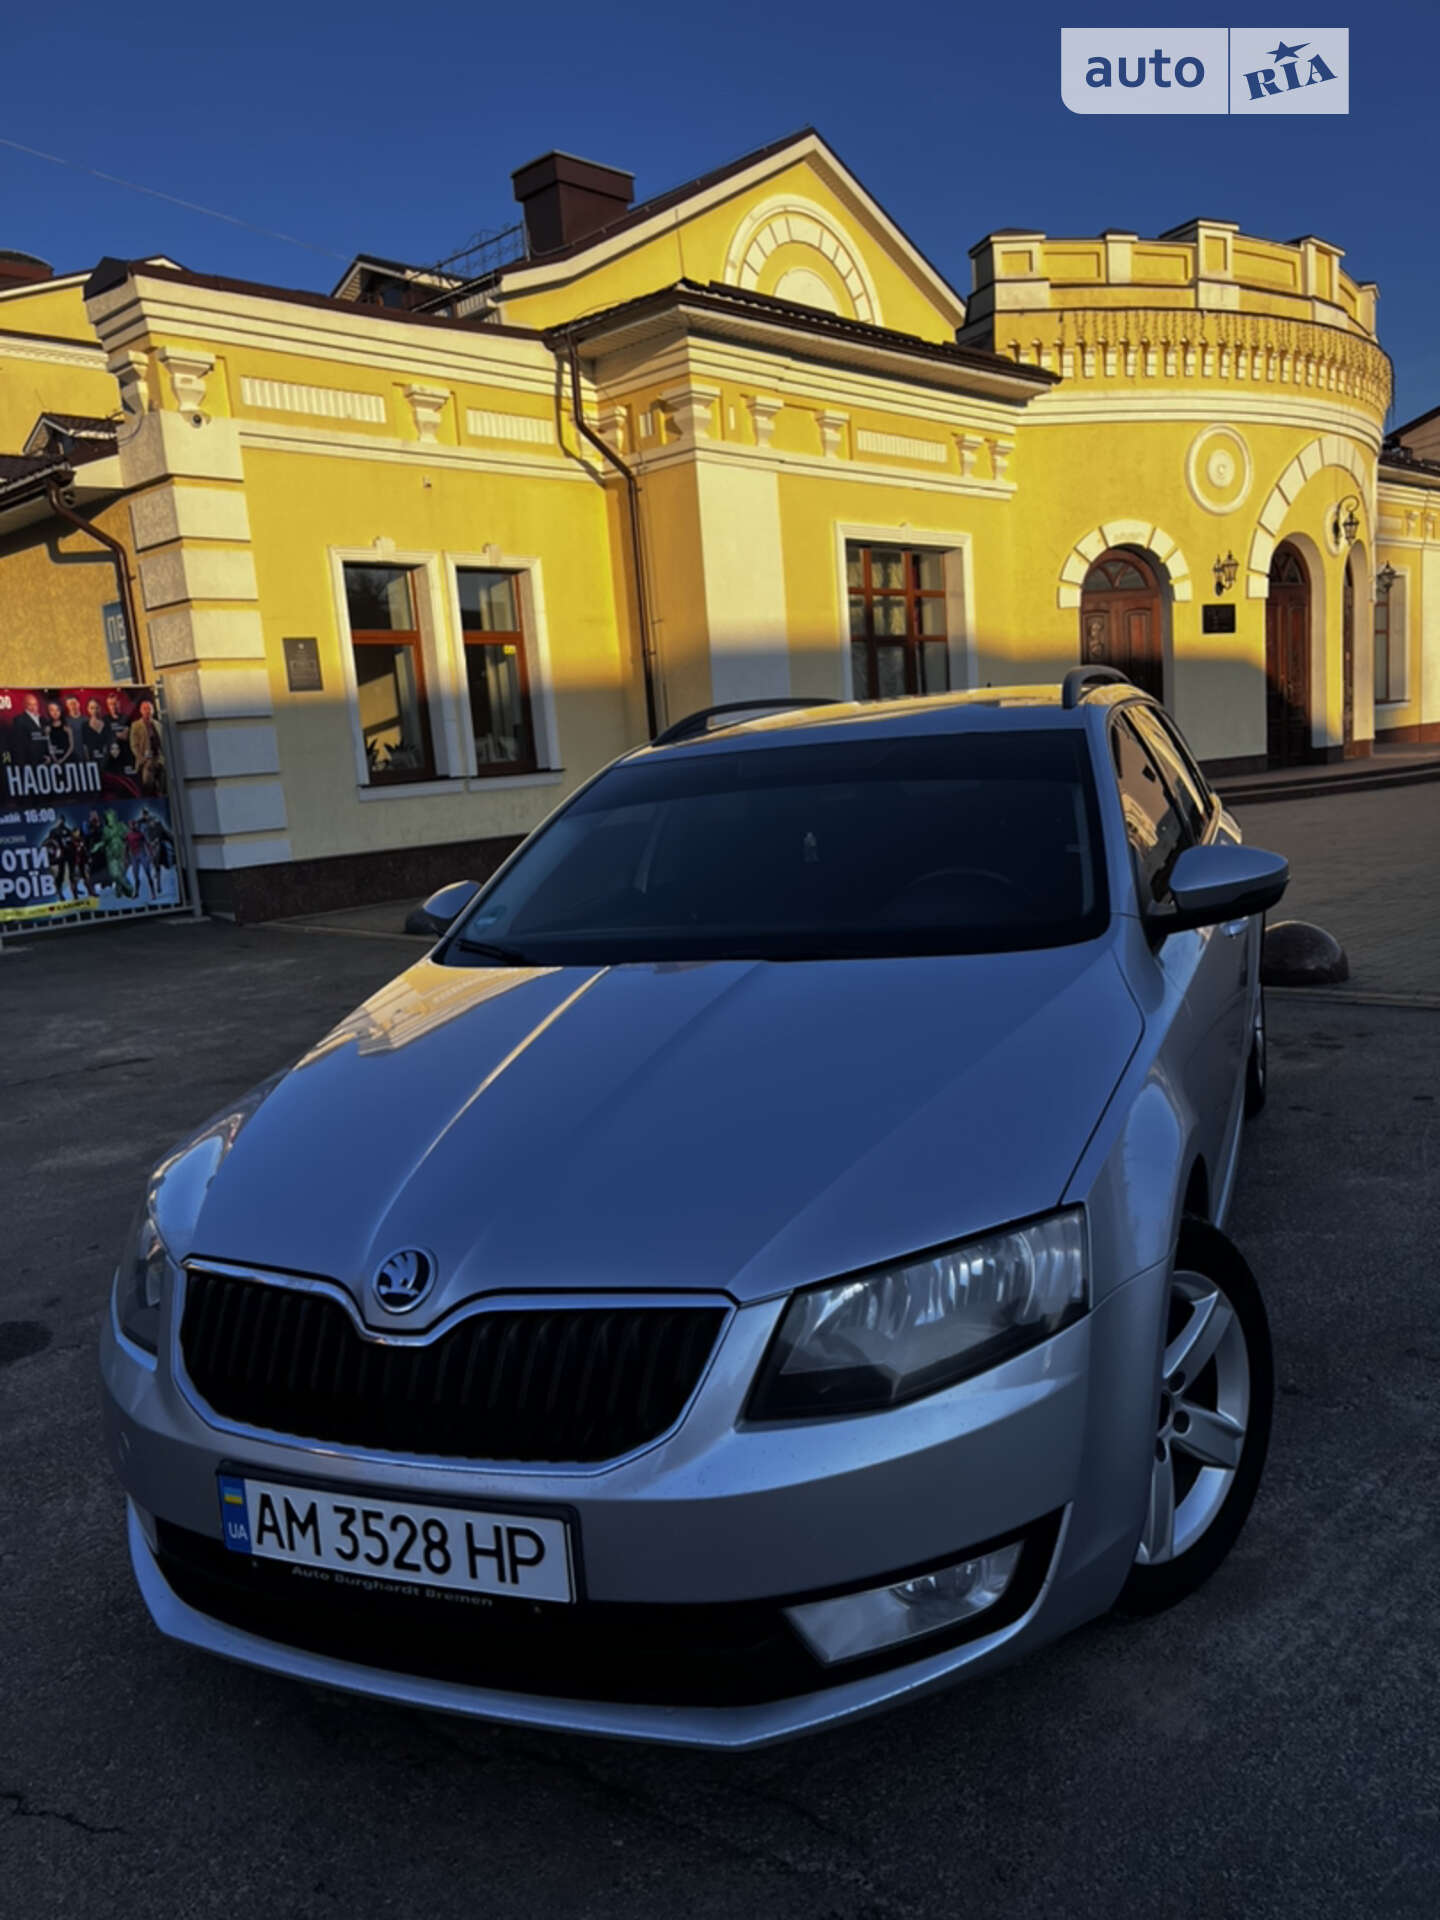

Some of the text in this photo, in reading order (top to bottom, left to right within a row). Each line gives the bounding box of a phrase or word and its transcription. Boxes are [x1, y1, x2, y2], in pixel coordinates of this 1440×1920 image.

[7, 762, 101, 797] НАОСЛІП
[228, 1522, 248, 1541] UA
[256, 1493, 546, 1584] AM 3528 HP
[292, 1565, 330, 1581] Auto
